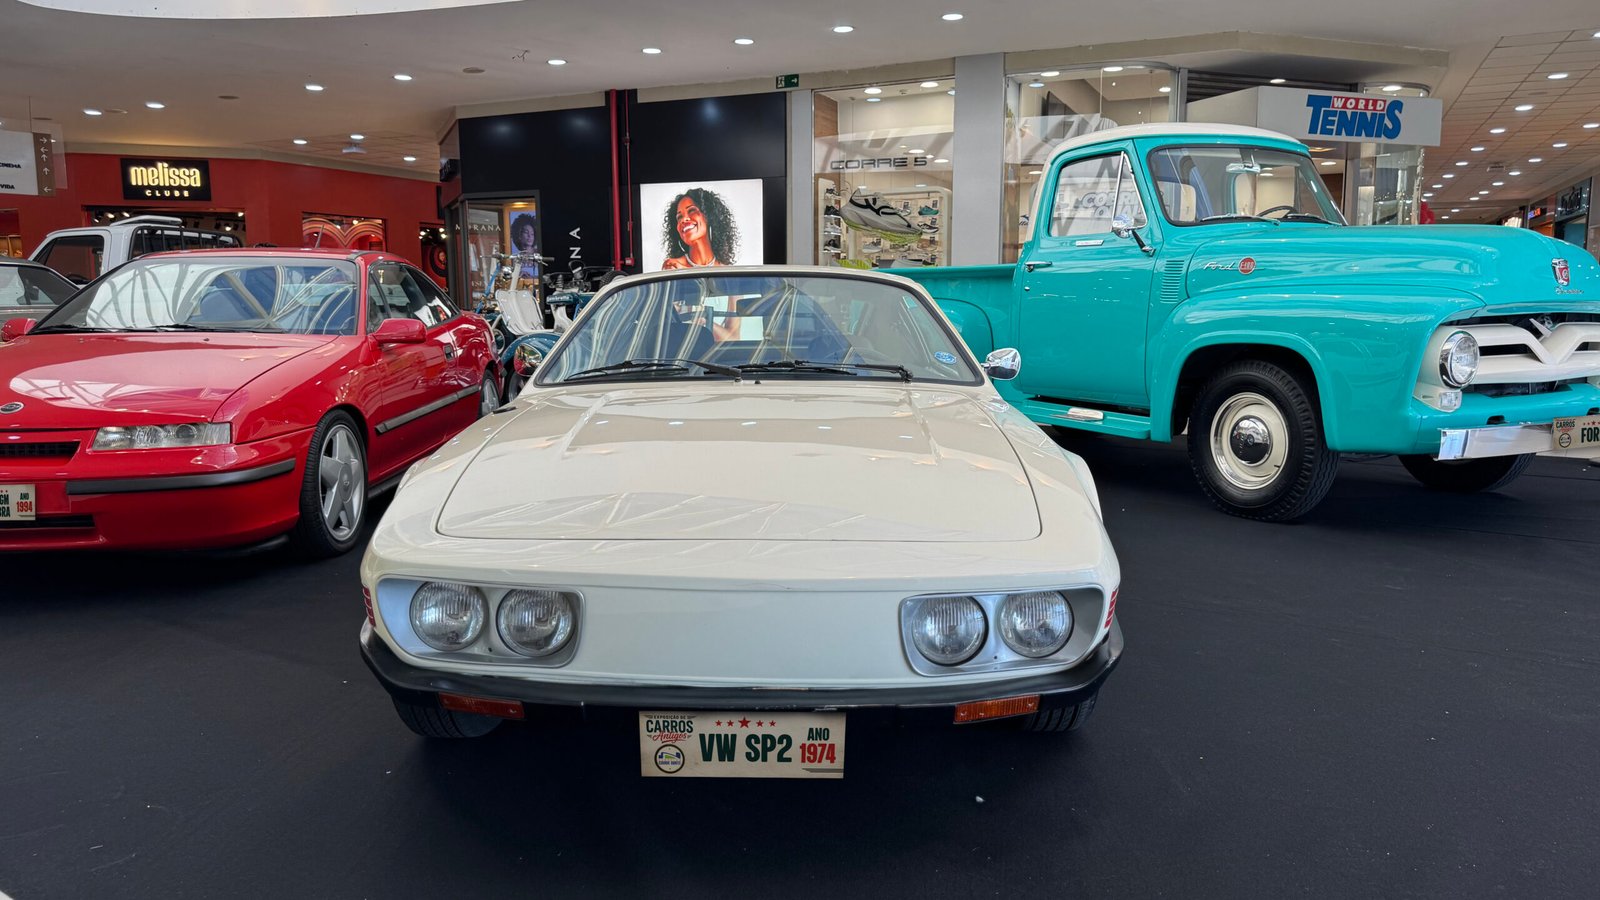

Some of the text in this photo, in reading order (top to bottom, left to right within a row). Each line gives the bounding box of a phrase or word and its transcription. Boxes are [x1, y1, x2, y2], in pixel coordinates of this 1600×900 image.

[1333, 98, 1385, 110] WORLD
[1306, 94, 1404, 139] TENNIS
[830, 156, 928, 170] CORRE 5
[130, 162, 201, 187] melissa
[1203, 262, 1235, 270] Ford
[16, 501, 33, 512] 1994
[646, 719, 694, 733] CARROS
[652, 730, 688, 743] Antigos
[807, 728, 830, 741] ANO
[699, 733, 793, 763] VW SP2
[800, 743, 836, 764] 1974
